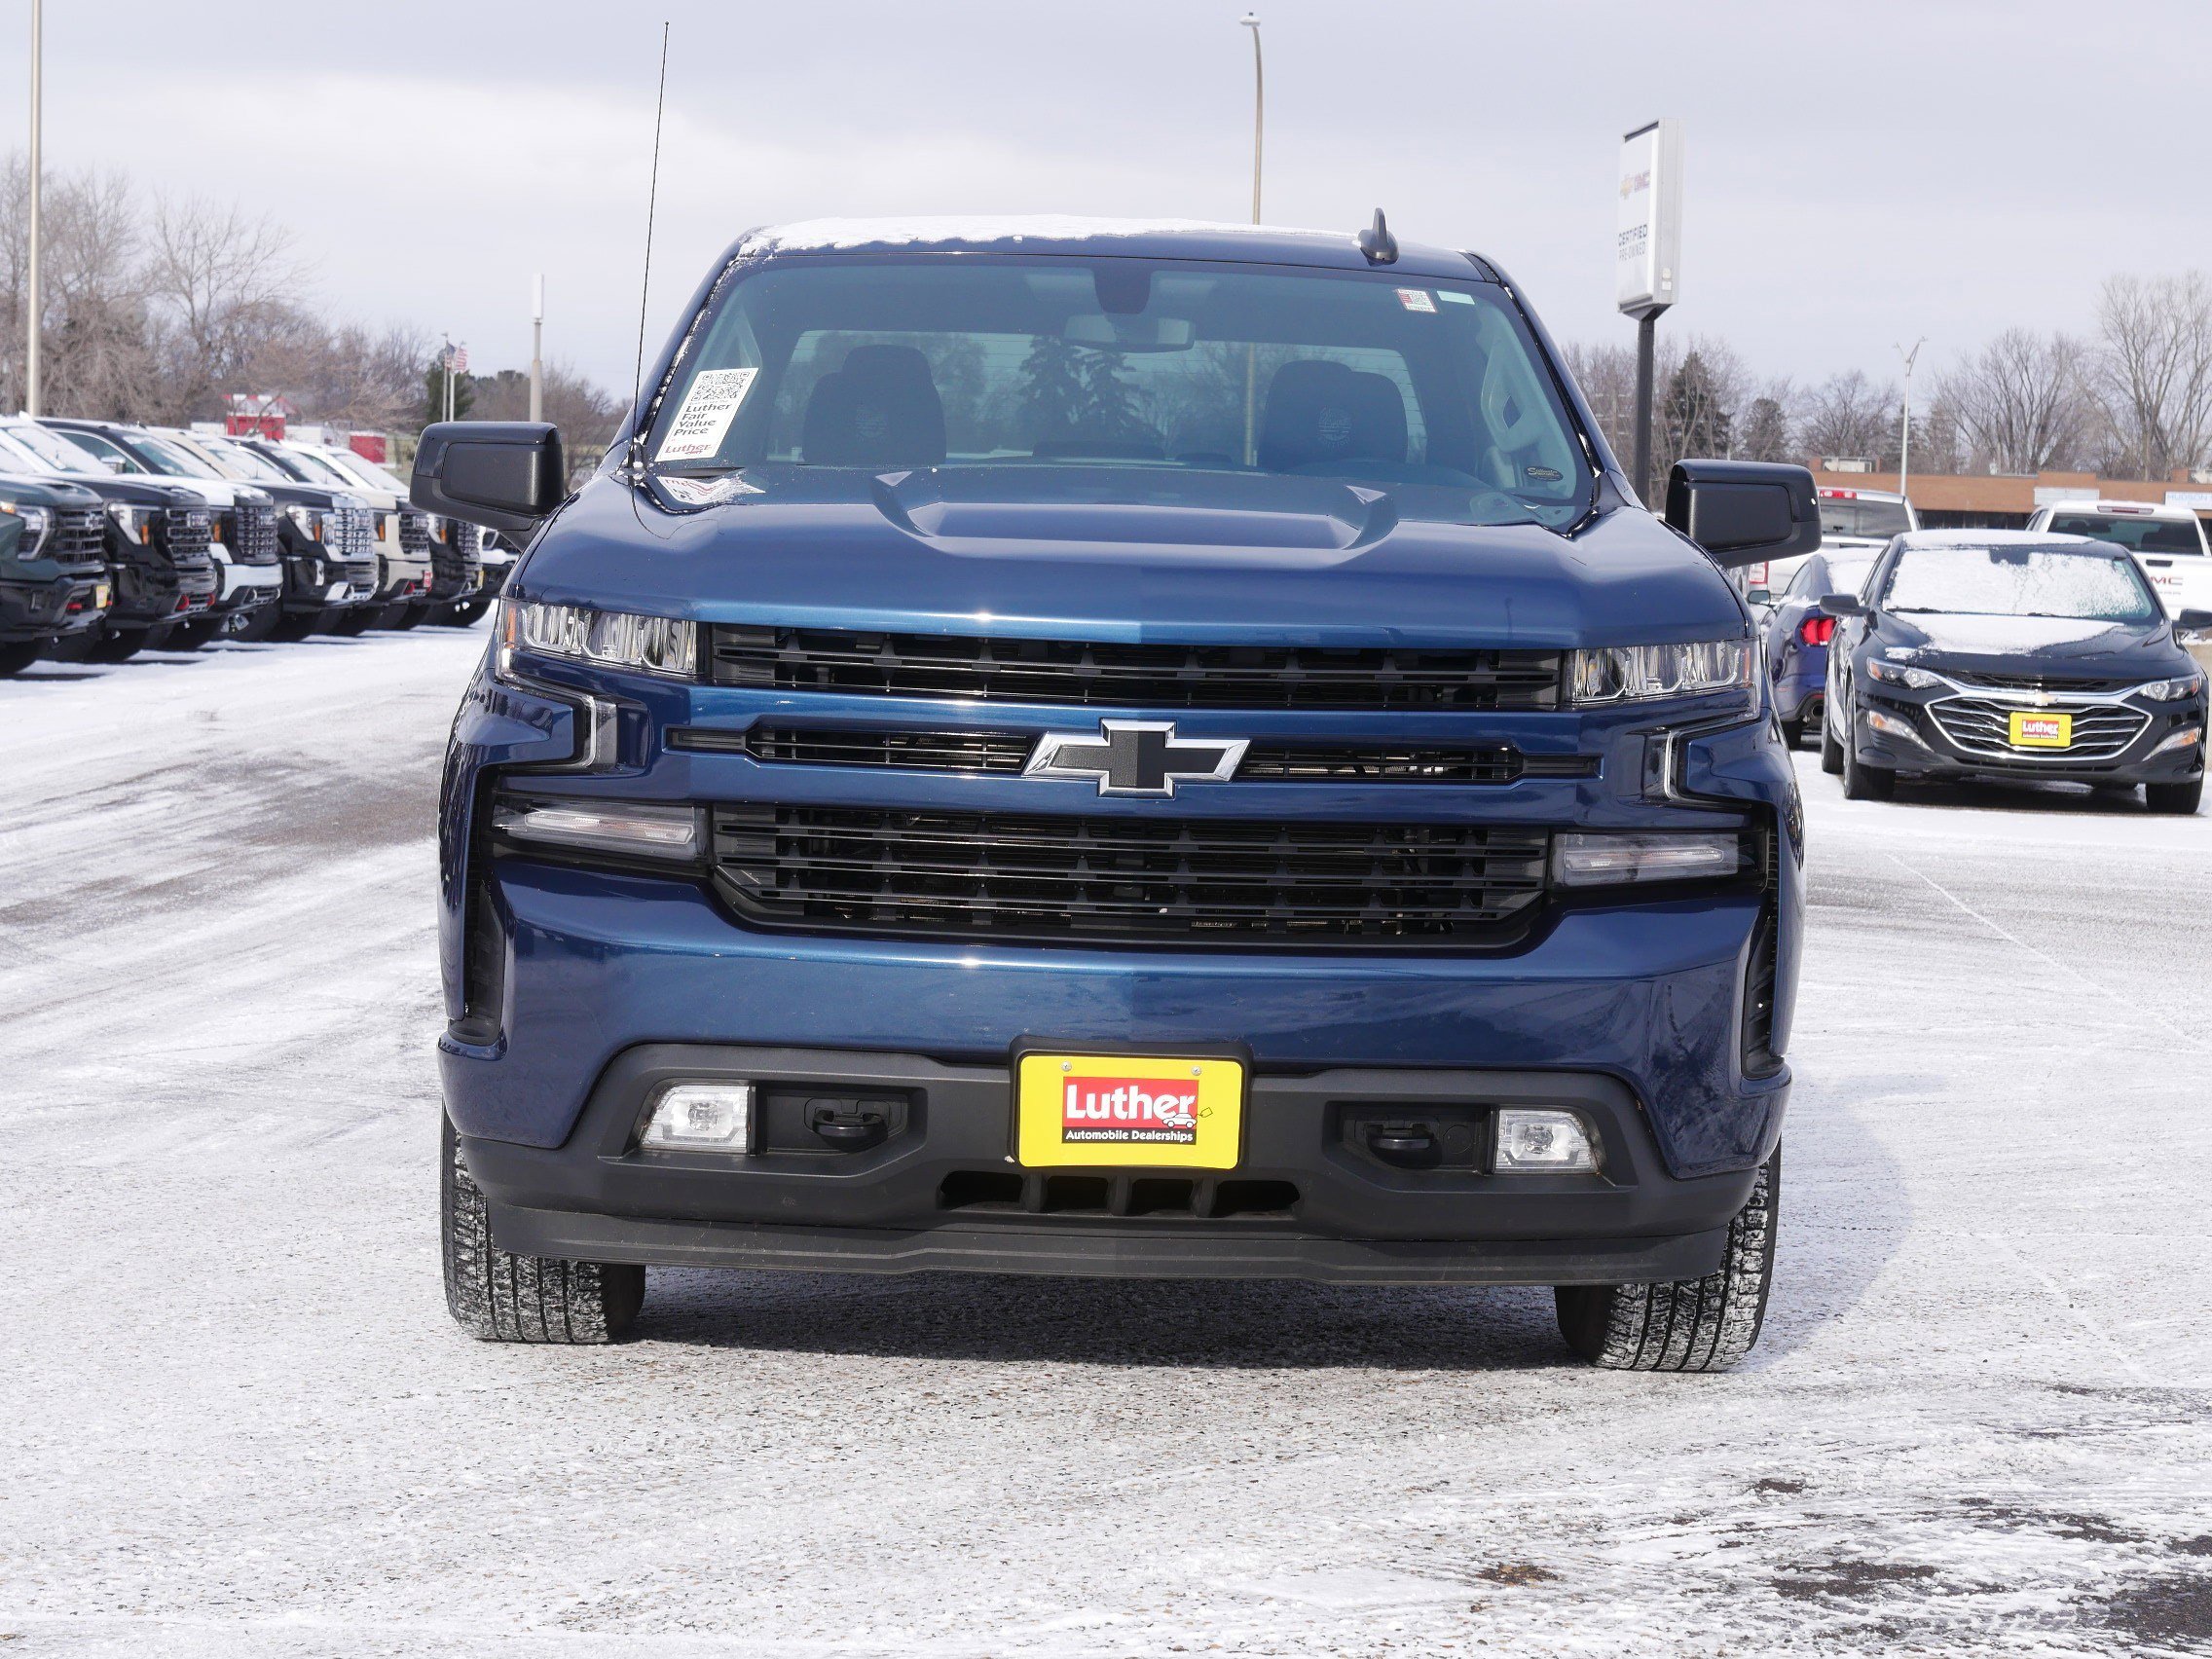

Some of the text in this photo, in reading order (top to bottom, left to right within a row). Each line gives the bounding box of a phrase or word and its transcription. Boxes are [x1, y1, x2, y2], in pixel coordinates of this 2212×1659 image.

[1618, 224, 1647, 246] CERTIFIED
[686, 404, 731, 413] Luther
[682, 412, 707, 421] Fair
[679, 420, 717, 428] Value
[674, 427, 709, 437] Price
[665, 444, 711, 453] Luther
[2150, 576, 2183, 586] MC
[2022, 720, 2058, 734] Luther
[1066, 1085, 1196, 1121] Luther
[1065, 1129, 1194, 1143] Automobile Dealerships
